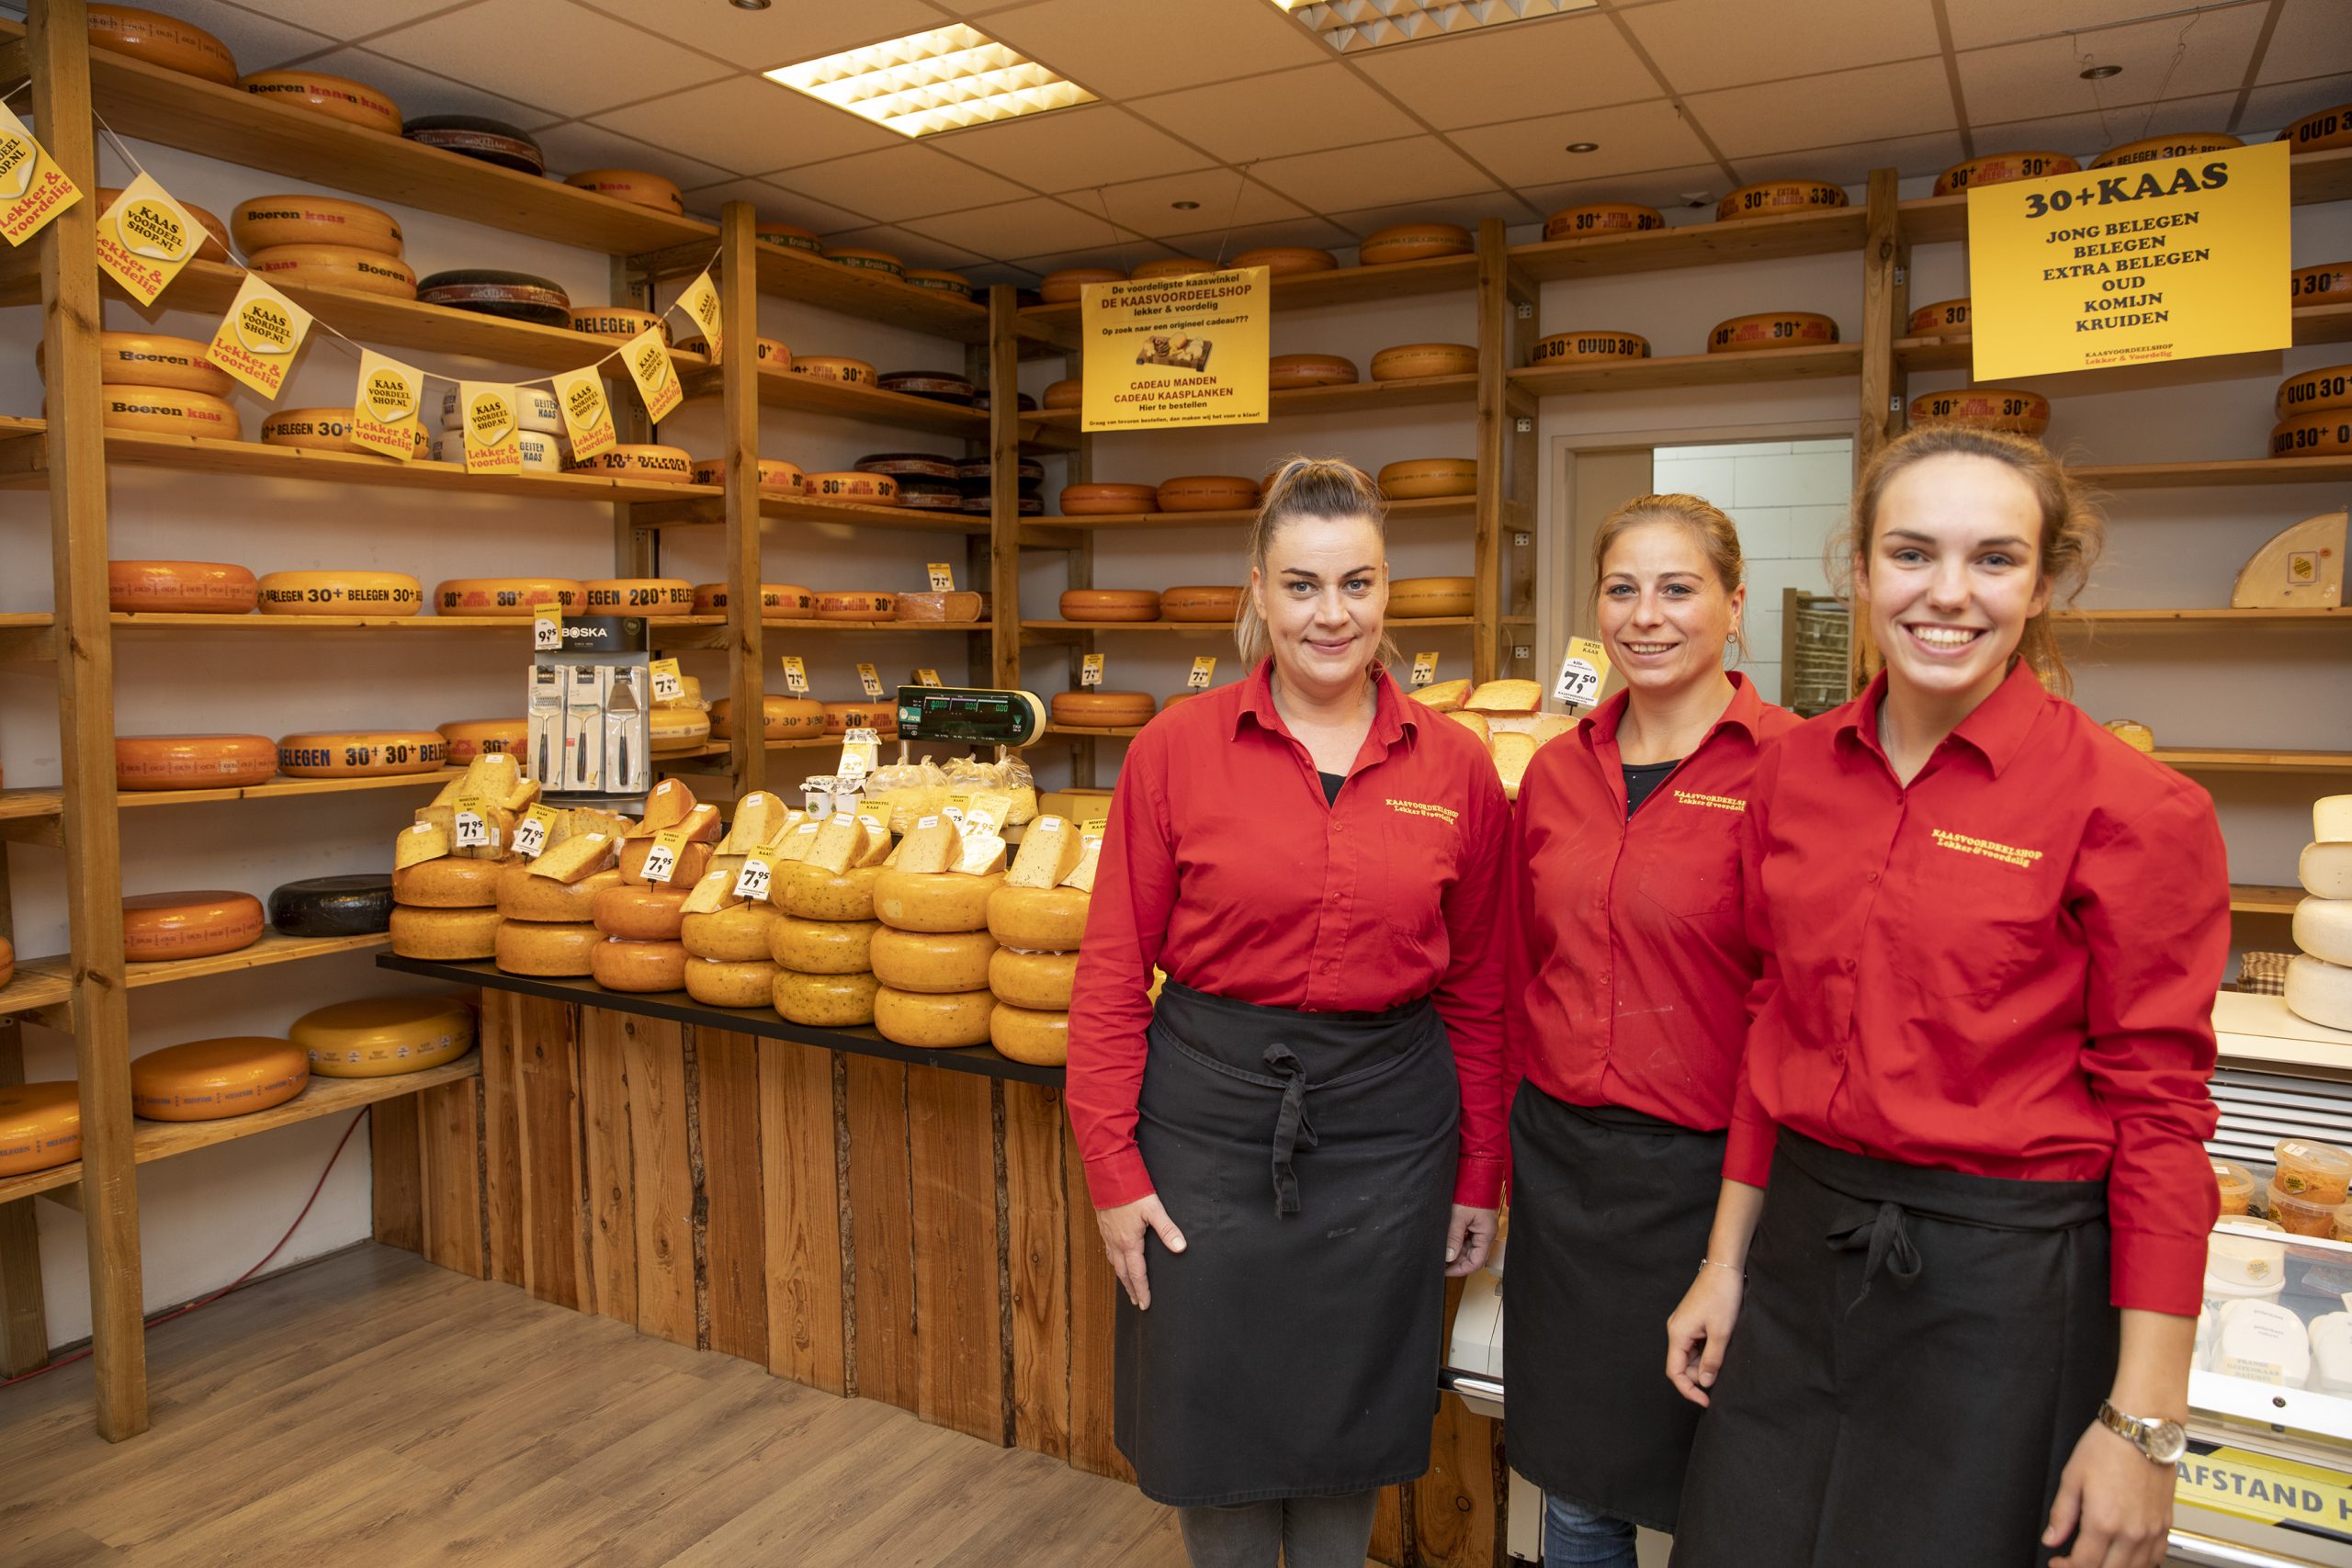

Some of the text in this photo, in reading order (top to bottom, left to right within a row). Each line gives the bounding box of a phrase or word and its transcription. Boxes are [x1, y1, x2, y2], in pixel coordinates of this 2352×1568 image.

[248, 84, 391, 116] Boeren kaas
[2300, 116, 2337, 143] OUD
[2118, 144, 2198, 167] BELEGEN 30+
[1951, 157, 2051, 188] 30+ 30+
[0, 171, 62, 228] Lekker &
[1745, 190, 1770, 209] 30+
[2025, 162, 2229, 219] 30+KAAS
[7, 179, 74, 237] voordelig
[248, 211, 345, 224] Boeren kaas
[127, 209, 183, 247] VOORDEEL
[140, 206, 179, 233] KAAS
[1577, 213, 1601, 230] 30+
[2045, 211, 2199, 244] JONG BELEGEN
[127, 220, 175, 252] SHOP.NL
[2074, 235, 2166, 258] BELEGEN
[265, 261, 405, 281] kaas Boeren
[2043, 249, 2210, 281] EXTRA BELEGEN
[149, 270, 164, 285] &
[1112, 274, 1239, 294] De voordeligste kaaswinkel
[2102, 276, 2145, 291] OUD
[2304, 273, 2343, 294] 30+
[1102, 285, 1252, 309] DE KAASVOORDEELSHOP
[2084, 292, 2163, 313] KOMIJN
[252, 306, 287, 327] KAAS
[1135, 307, 1161, 316] lekker
[1176, 301, 1217, 313] voordelig
[243, 312, 291, 339] VOORDEEL
[575, 317, 635, 333] BELEGEN
[1170, 320, 1204, 330] origineel
[1206, 315, 1249, 325] cadeau???
[2075, 310, 2169, 333] KRUIDEN
[244, 322, 285, 344] SHOP.NL
[1716, 321, 1802, 344] 30+ 30+
[1549, 340, 1640, 355] 30+ 30+
[2086, 344, 2173, 357] KAASVOORDEELSHOP
[119, 351, 188, 366] Boeren
[215, 337, 281, 378] Lekker &
[639, 348, 656, 368] KAAS
[640, 352, 662, 378] VOORDEEL
[2086, 355, 2118, 365] Lekker
[2129, 350, 2172, 360] Voordelig
[212, 349, 278, 389] voordelig
[645, 360, 663, 382] SHOP.NL
[375, 379, 403, 391] KAAS
[1131, 376, 1216, 389] CADEAU MANDEN
[368, 389, 411, 400] VOORDEEL
[372, 396, 408, 407] SHOP.NL
[569, 391, 598, 413] VOORDEEL
[570, 385, 593, 404] KAAS
[648, 378, 678, 412] Lekker &
[651, 387, 682, 418] voordelig
[1114, 388, 1233, 402] CADEAU KAASPLANKEN
[2288, 382, 2315, 404] OUD
[112, 402, 221, 422] Boeren kaas
[476, 402, 502, 414] KAAS
[575, 400, 600, 419] SHOP.NL
[1169, 400, 1207, 409] bestellen
[1933, 399, 2029, 416] 30+ 30+
[472, 410, 508, 423] VOORDEEL
[477, 418, 508, 430] SHOP.NL
[277, 422, 353, 437] BELEGEN 30+
[356, 418, 413, 440] Lekker &
[572, 421, 613, 447] Lekker &
[356, 431, 413, 451] voordelig
[520, 442, 544, 452] GEITEN
[577, 431, 616, 457] voordelig
[2274, 427, 2328, 453] OUD 30+
[468, 444, 518, 460] Lekker &
[470, 455, 520, 468] voordelig
[524, 452, 542, 462] KAAS
[823, 479, 846, 493] 30+
[878, 482, 893, 496] 30+
[308, 588, 414, 602] 30+ BELEGEN 30+
[444, 591, 524, 607] 30+ 30+
[538, 628, 557, 643] 9,95
[562, 626, 607, 638] BOSKA
[655, 678, 676, 693] 7,95
[1565, 671, 1597, 694] 7,50
[845, 714, 868, 727] 30+
[278, 745, 417, 766] BELEGEN 30+ 30+
[482, 739, 510, 754] 30+
[1385, 799, 1459, 818] KAASVOORDEELSHOP
[1395, 806, 1420, 815] Lekker
[1679, 797, 1705, 806] Lekker
[1713, 803, 1745, 812] voordeli
[459, 821, 482, 837] 7,95
[522, 827, 544, 845] 7,95
[1932, 829, 2042, 860] KAASVOORDEELSHOP
[1937, 838, 1972, 853] Lekker
[1983, 850, 2030, 867] voordelig
[649, 855, 673, 873] 7,95
[743, 869, 770, 888] 7,95
[2177, 1461, 2324, 1513] AFSTAND
